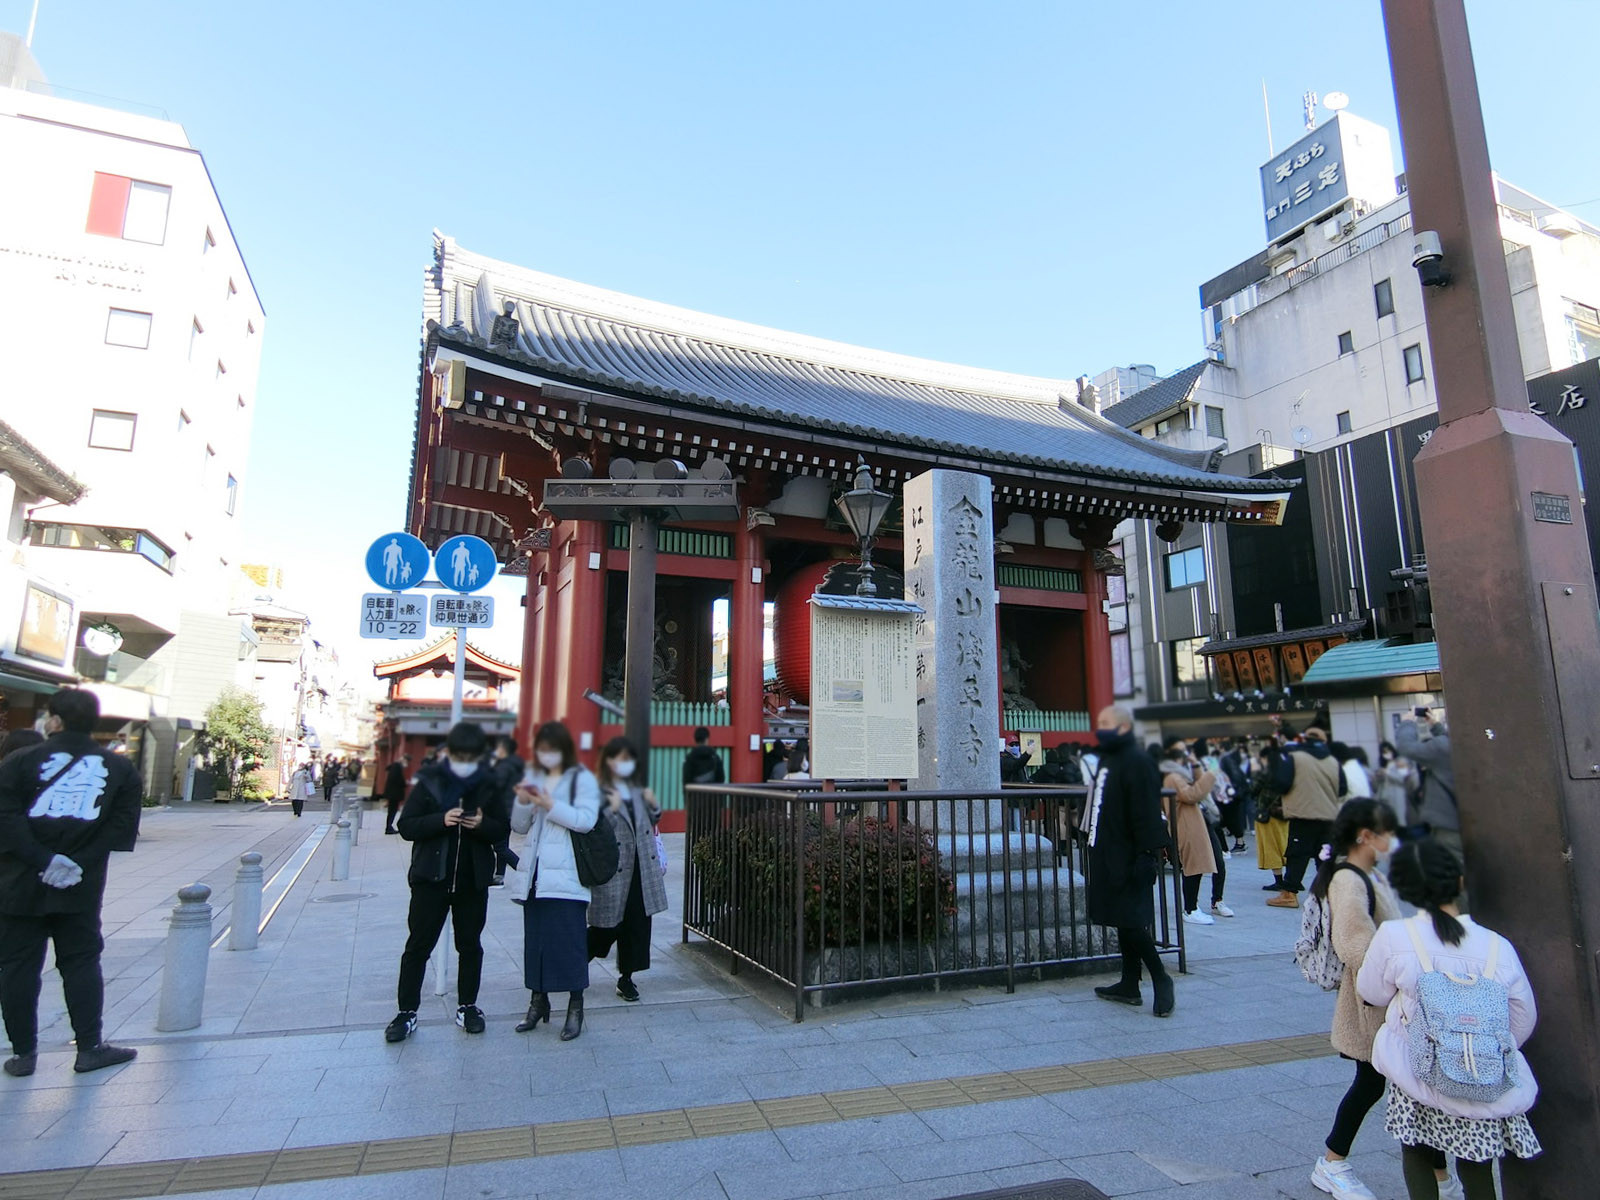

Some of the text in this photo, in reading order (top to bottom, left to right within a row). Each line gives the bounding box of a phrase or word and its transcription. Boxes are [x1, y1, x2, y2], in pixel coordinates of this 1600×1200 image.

[366, 598, 395, 609] 自転車
[399, 603, 422, 615] を除く
[435, 599, 489, 611] 自転車を除く
[366, 609, 394, 620] 人力車
[435, 612, 489, 624] 仲見世通り
